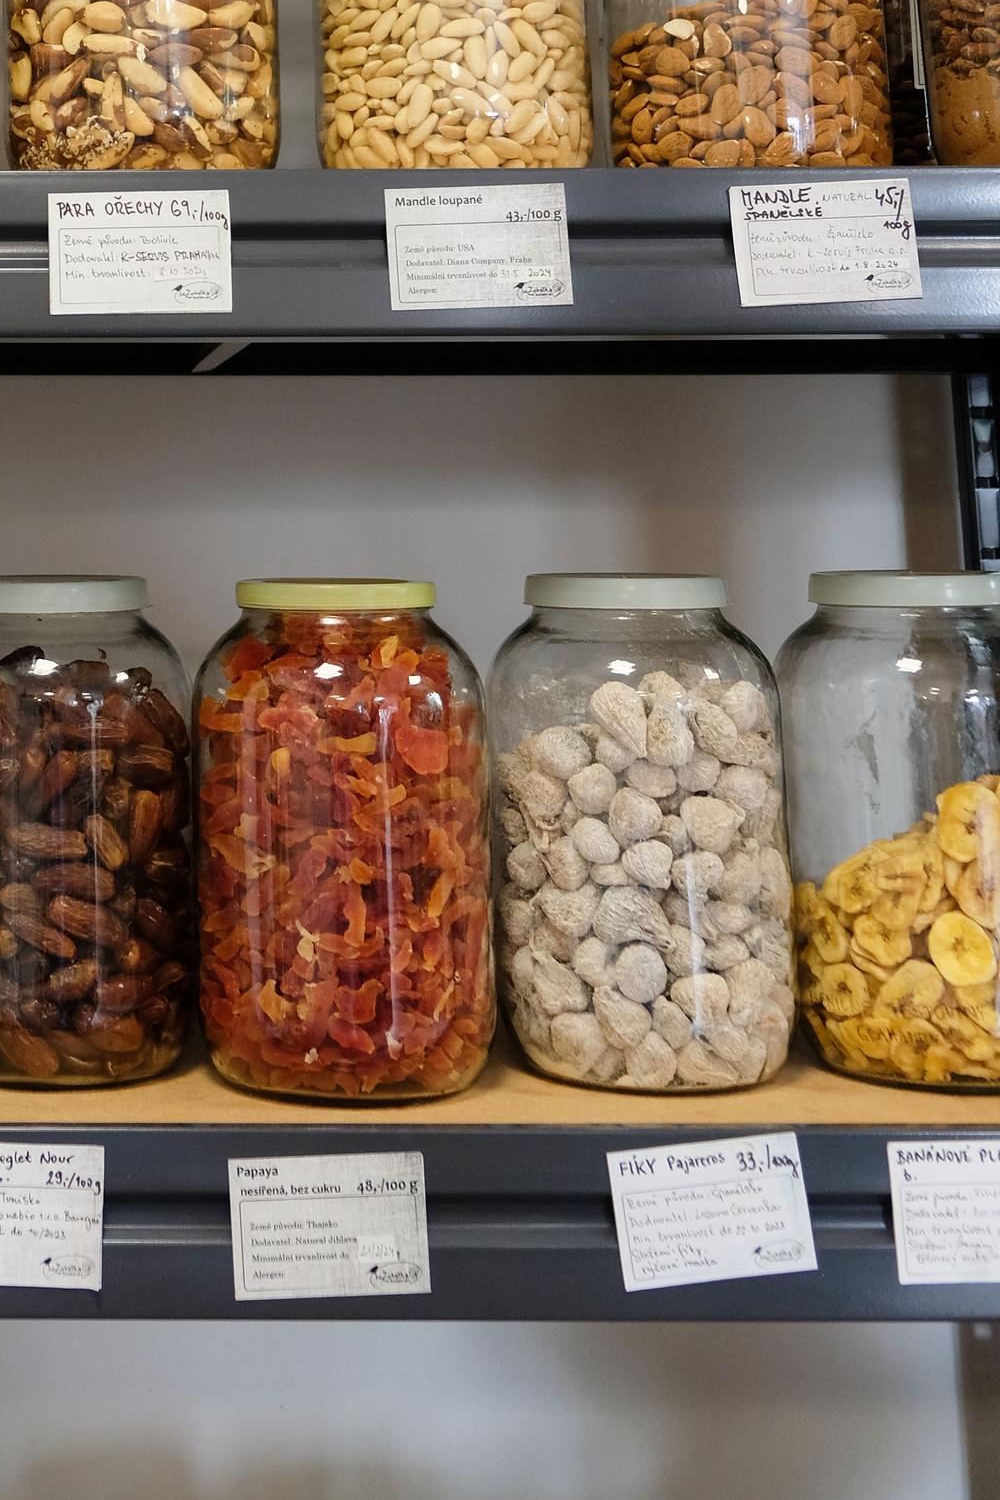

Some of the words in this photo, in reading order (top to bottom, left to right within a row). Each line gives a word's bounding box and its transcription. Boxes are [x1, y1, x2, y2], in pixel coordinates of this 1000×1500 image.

[394, 196, 437, 208] Mandle
[438, 194, 484, 209] loupané
[741, 186, 812, 208] MANDLE
[820, 192, 872, 203] NATURAL
[57, 201, 96, 220] PARA
[104, 196, 163, 217] OŘECHY
[505, 207, 551, 223] 43,-/100
[553, 210, 562, 222] g
[743, 200, 823, 221] ŠPANĚLSKÉ
[140, 233, 179, 246] Bolivie
[403, 245, 425, 254] Země
[457, 244, 475, 252] USA
[404, 258, 446, 268] Dodavatel:
[447, 257, 469, 266] Diana
[509, 255, 533, 265] Praha
[406, 271, 446, 282] Minimální
[447, 271, 487, 281] trvanlivost
[488, 270, 498, 279] do
[39, 1150, 76, 1166] Nour
[896, 1144, 974, 1167] BANÁNOVÉ
[618, 1153, 658, 1178] FÍKY
[665, 1151, 727, 1175] Pajareros
[236, 1166, 280, 1181] Papaya
[239, 1183, 289, 1198] nesířená,
[290, 1182, 309, 1196] bez
[310, 1181, 342, 1195] cukru
[355, 1177, 407, 1197] 48,-/100
[409, 1178, 419, 1196] g
[249, 1221, 272, 1232] Země
[306, 1219, 339, 1232] Thajsko
[250, 1236, 292, 1248] Dodavatel:
[295, 1235, 327, 1247] Natural
[328, 1234, 359, 1246] Jihlava
[251, 1252, 294, 1265] Minimální
[294, 1251, 338, 1264] trvanlivost
